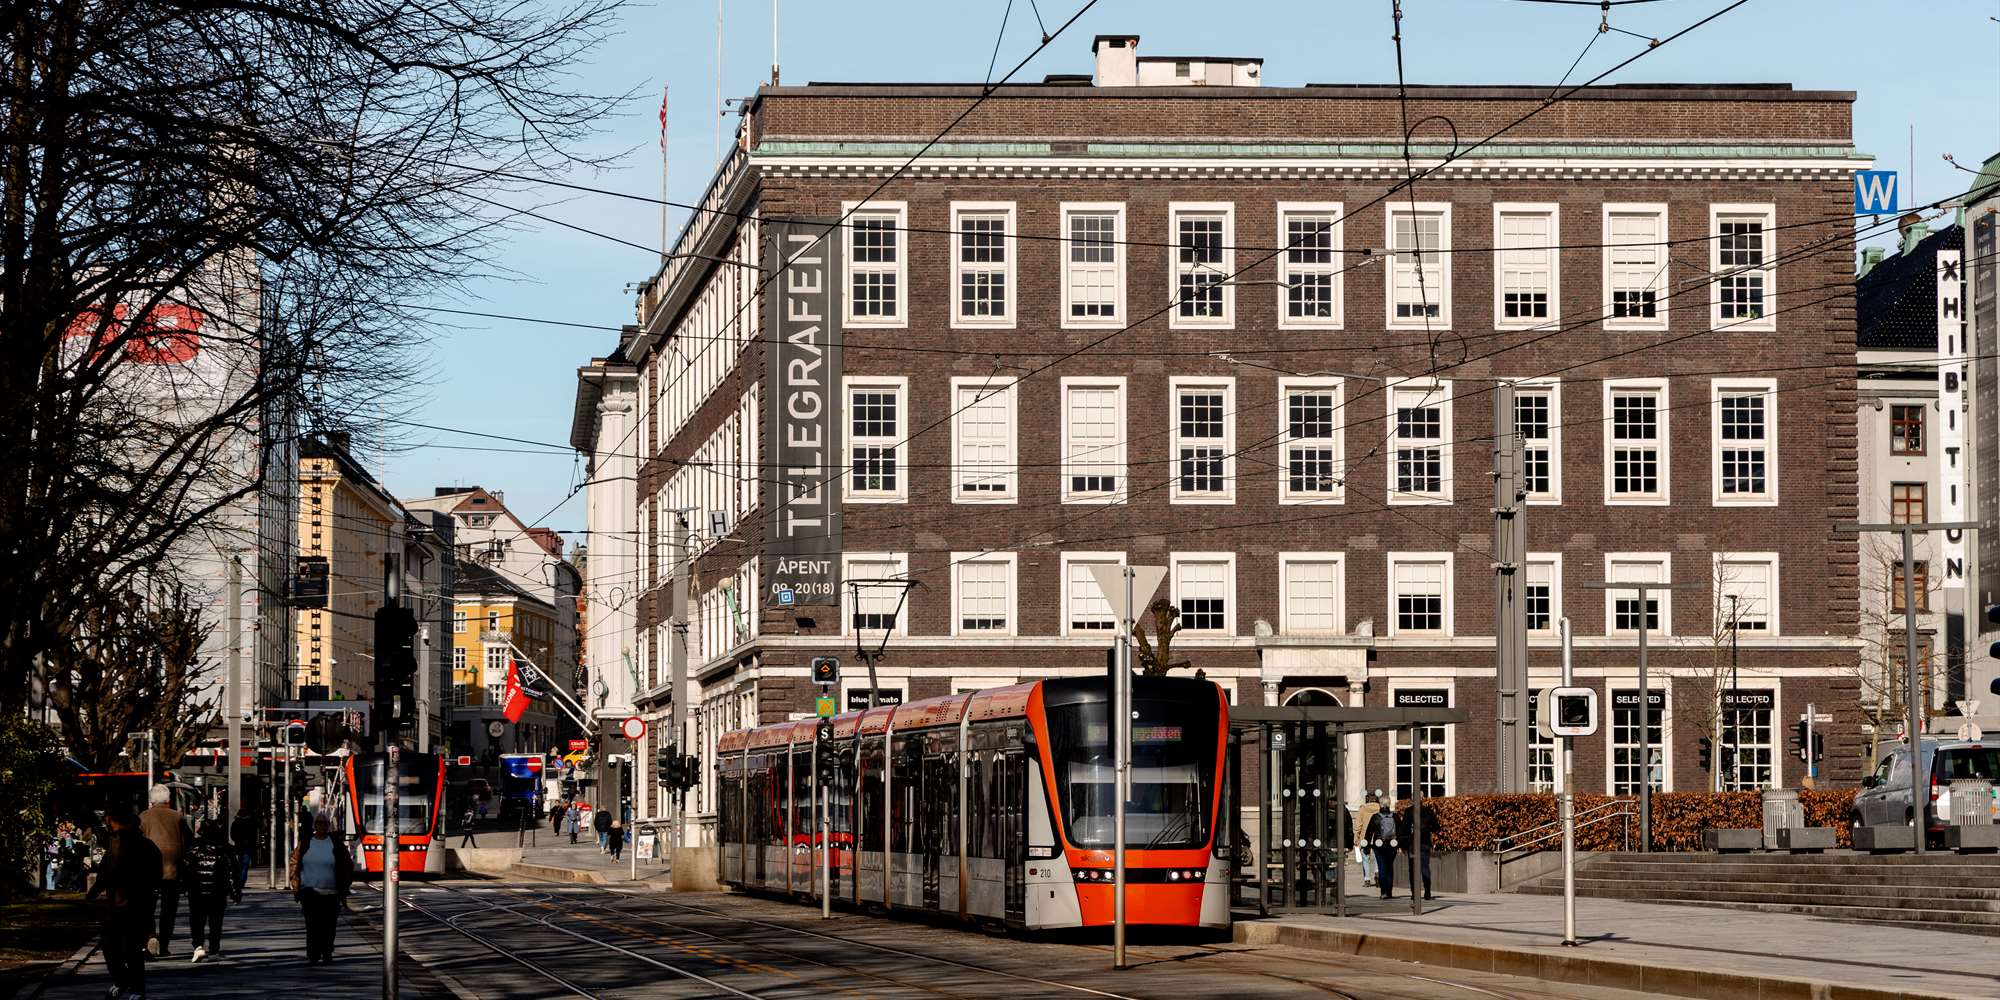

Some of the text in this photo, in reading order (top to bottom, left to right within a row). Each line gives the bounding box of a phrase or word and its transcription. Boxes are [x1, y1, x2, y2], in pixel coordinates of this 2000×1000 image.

[1856, 174, 1896, 211] W
[787, 234, 822, 537] TELEGRAFEN
[711, 512, 727, 534] H
[776, 556, 832, 575] ÅPENT
[1399, 695, 1444, 703] SELECTED
[1616, 695, 1661, 704] SELEED
[820, 727, 829, 740] S
[295, 763, 301, 772] S
[1040, 868, 1051, 878] 210
